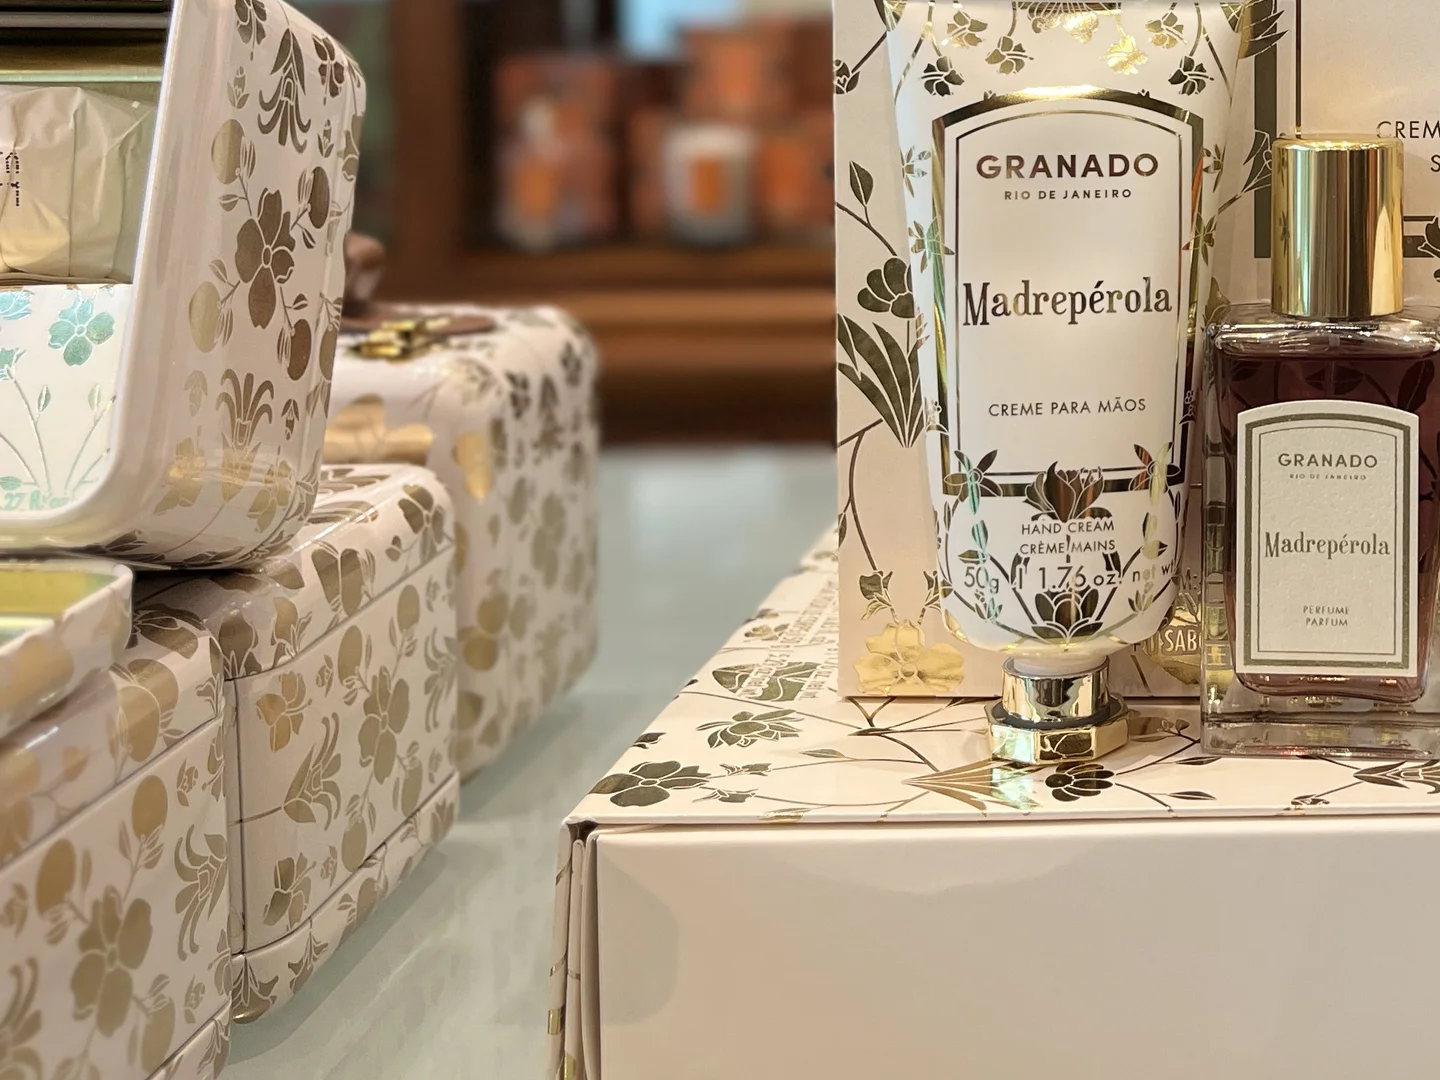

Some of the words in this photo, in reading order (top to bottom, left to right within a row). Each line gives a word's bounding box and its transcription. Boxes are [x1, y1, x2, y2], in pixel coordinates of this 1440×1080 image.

[976, 153, 1159, 179] GRANADO
[1004, 190, 1031, 201] RIO
[1038, 189, 1056, 200] DE
[1062, 188, 1132, 200] JANEIRO
[963, 277, 1173, 326] Madrepérola
[988, 401, 1043, 417] CREME
[1051, 400, 1091, 415] PARA
[1098, 396, 1147, 414] MÃOS
[1278, 453, 1378, 468] GRANADO
[1021, 522, 1062, 535] HAND
[1067, 520, 1115, 534] CREAM
[1020, 541, 1065, 555] CRÈME
[1070, 539, 1116, 554] MAINS
[1265, 531, 1390, 559] Madrepérola
[964, 566, 999, 594] 50g
[1303, 605, 1349, 615] PERFUME
[1305, 617, 1348, 627] PARFUM
